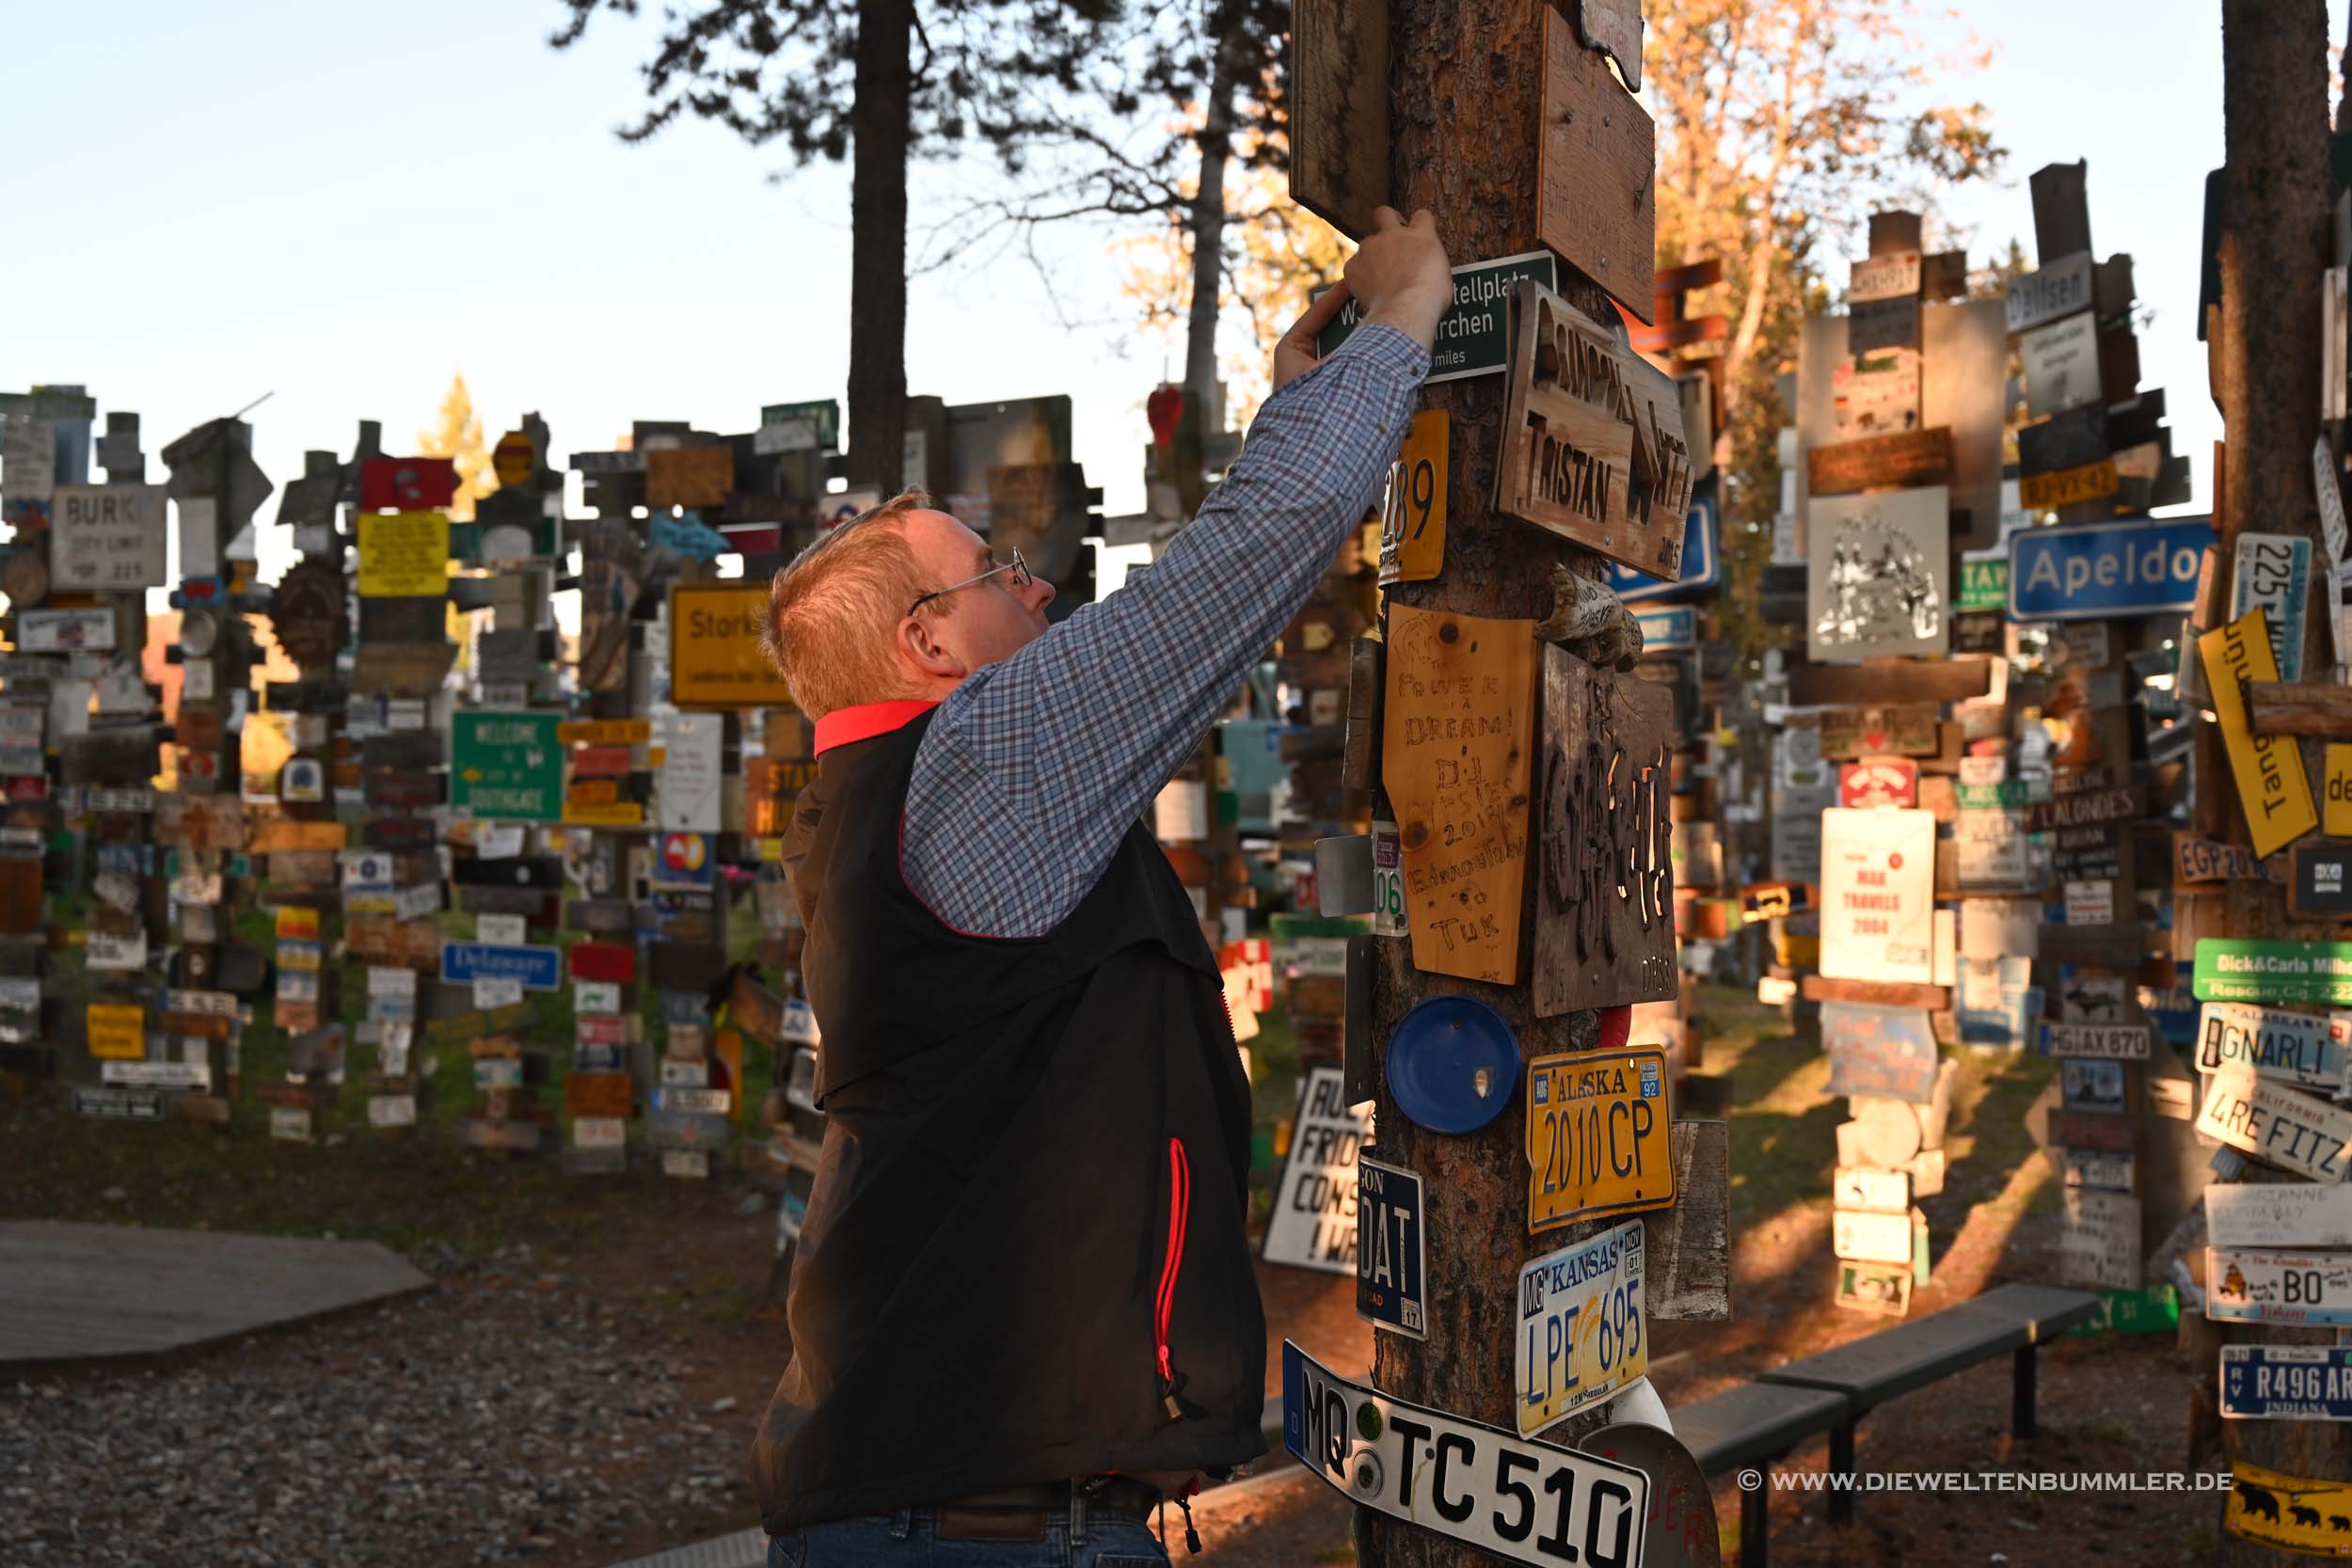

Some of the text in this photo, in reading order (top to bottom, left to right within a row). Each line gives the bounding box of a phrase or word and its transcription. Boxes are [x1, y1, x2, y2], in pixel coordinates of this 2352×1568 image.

[1526, 409, 1612, 523] TRISTAN
[2026, 539, 2199, 597] Apeldo
[1557, 1069, 1628, 1103] ALASKA
[1644, 1083, 1657, 1097] 92
[1625, 1227, 1640, 1251] NOV
[1550, 1238, 1619, 1295] KANSAS
[1629, 1256, 1639, 1270] 01
[1524, 1270, 1545, 1315] MG
[2283, 1269, 2322, 1305] BO
[1406, 1309, 1418, 1326] 17
[1527, 1277, 1641, 1405] LPE 695
[1303, 1370, 1351, 1481] MQ
[1492, 1448, 1633, 1568] 510
